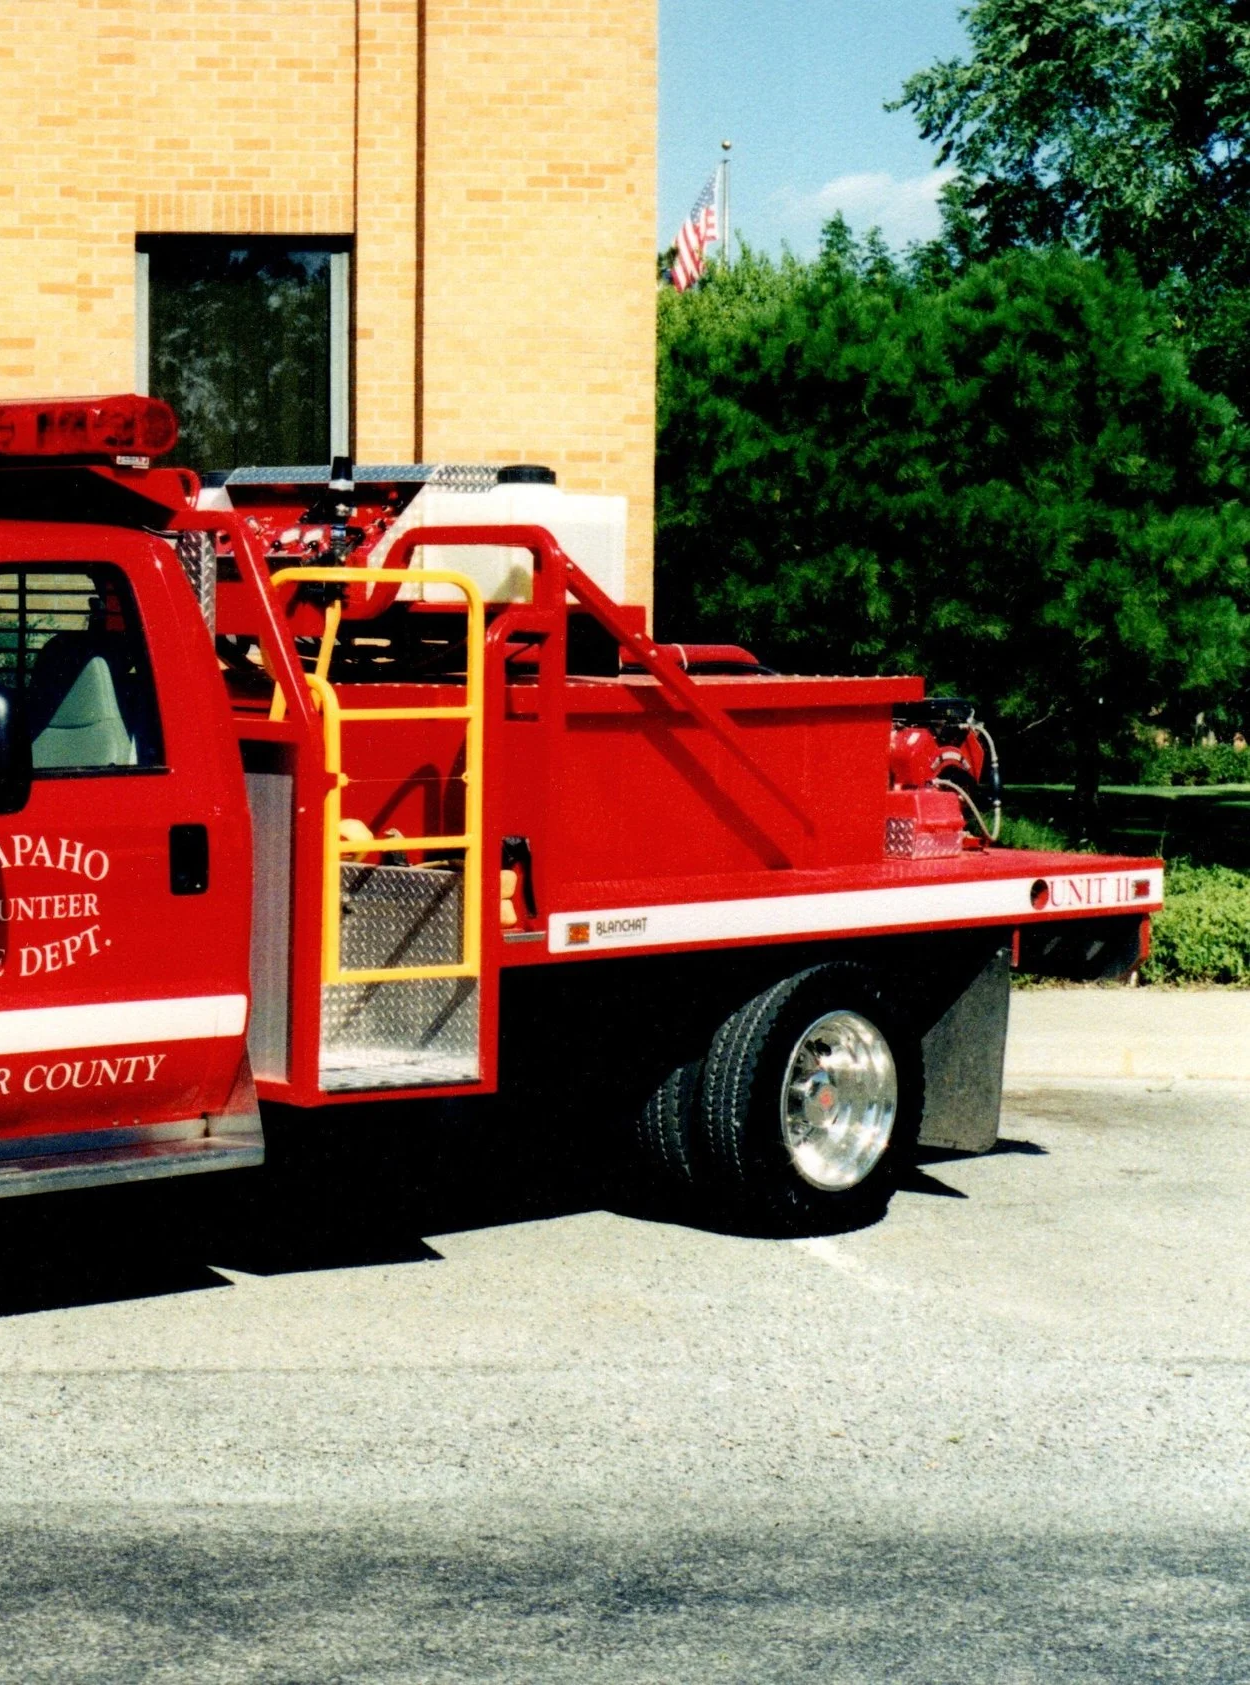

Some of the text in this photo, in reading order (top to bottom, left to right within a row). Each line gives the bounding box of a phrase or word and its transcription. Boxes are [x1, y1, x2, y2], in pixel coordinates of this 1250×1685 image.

[1050, 877, 1129, 907] UNIT 11
[596, 917, 648, 936] BLANCHAT
[19, 924, 112, 977] DEPT.
[23, 1054, 166, 1093] COUNTY
